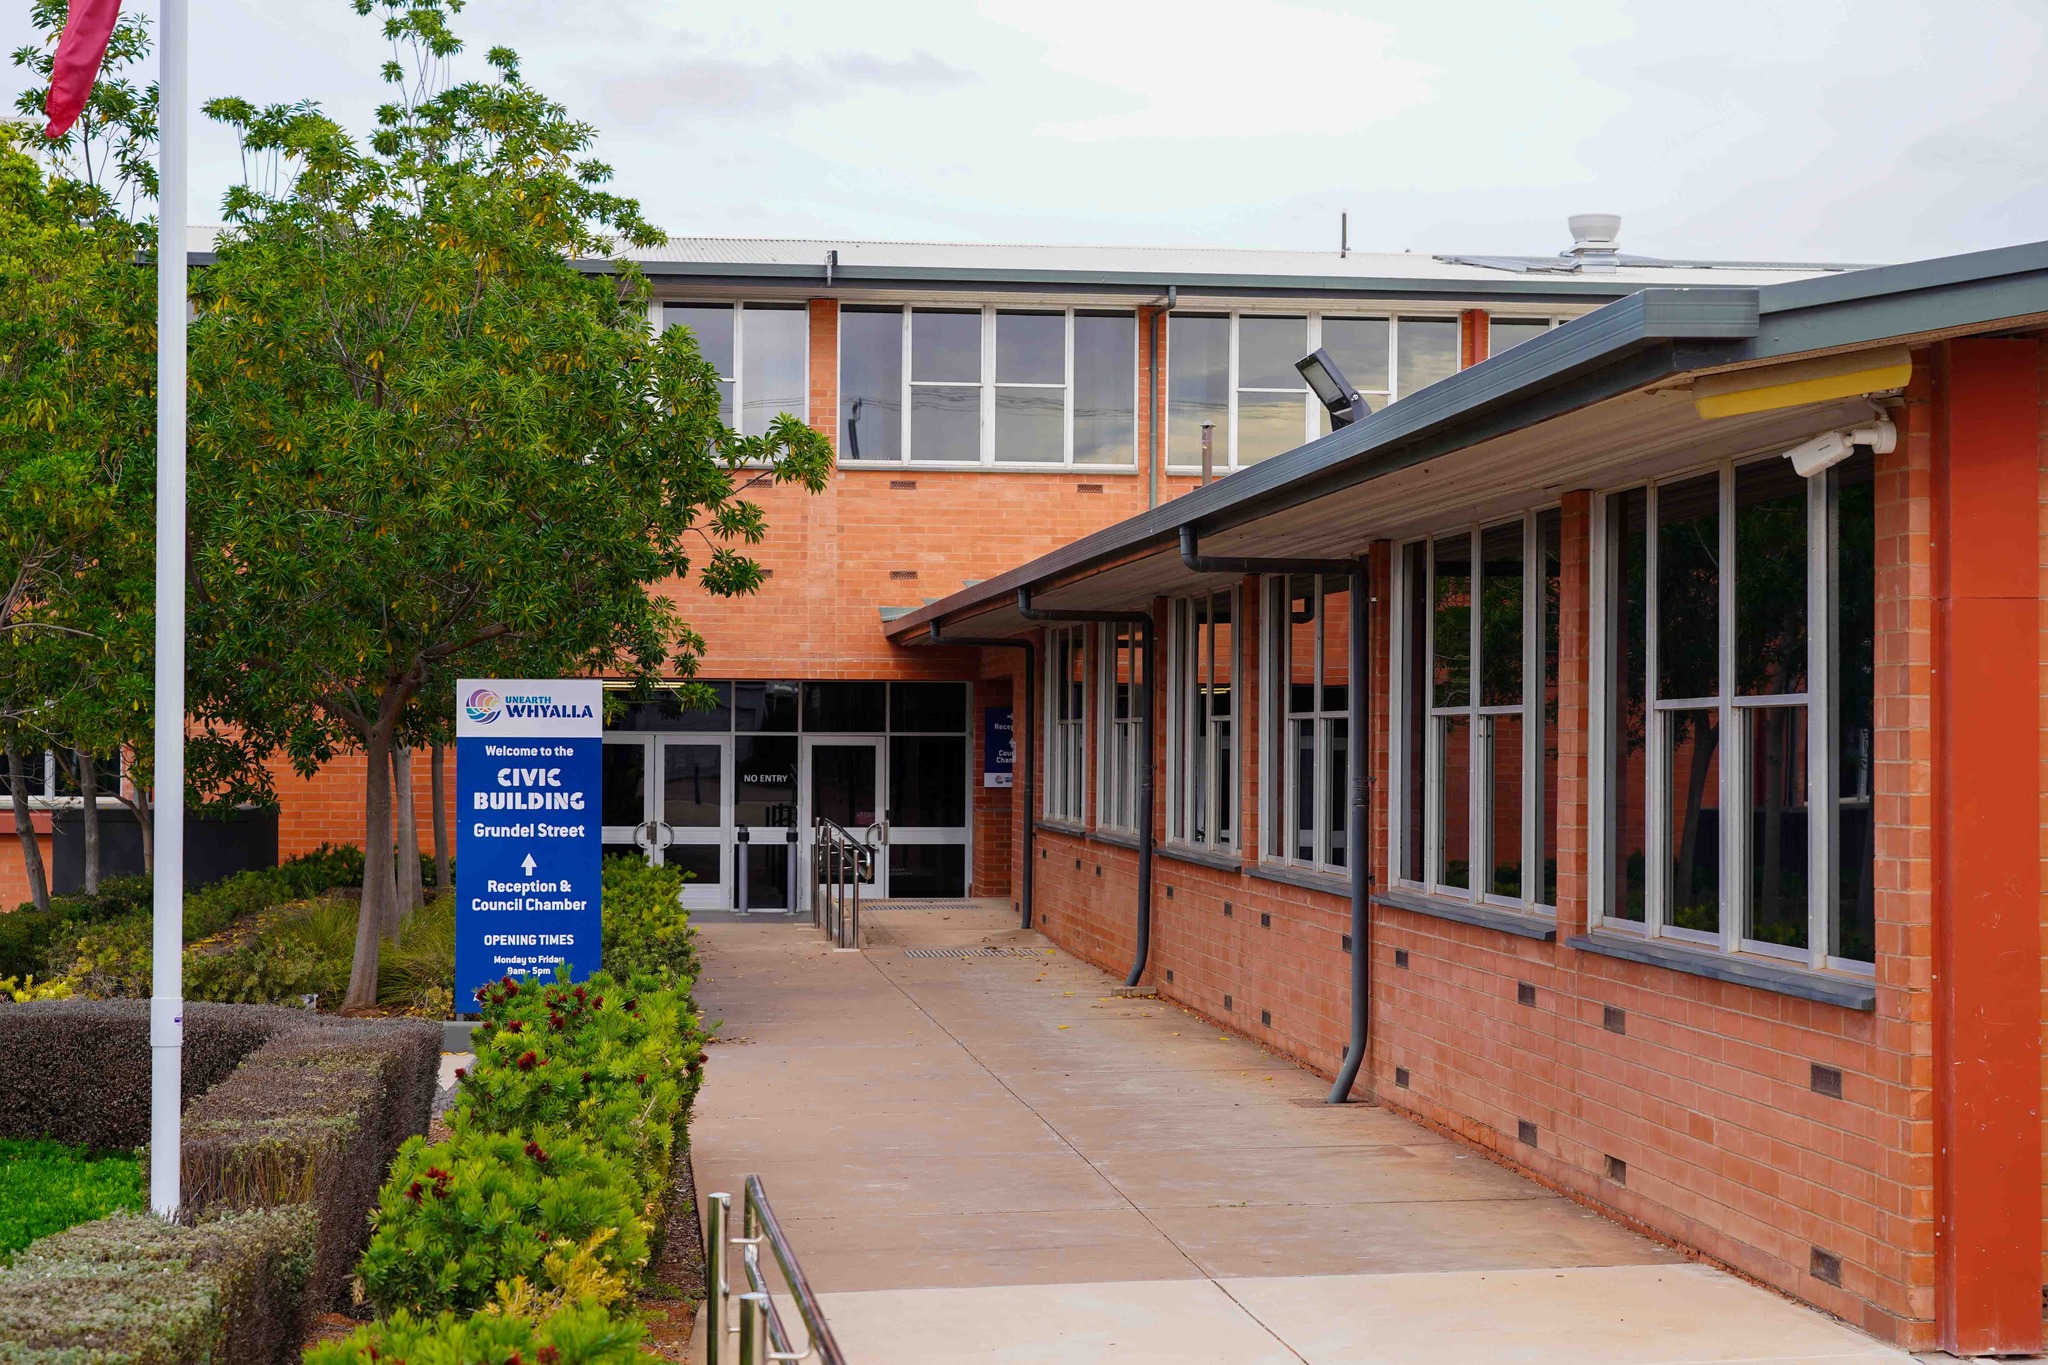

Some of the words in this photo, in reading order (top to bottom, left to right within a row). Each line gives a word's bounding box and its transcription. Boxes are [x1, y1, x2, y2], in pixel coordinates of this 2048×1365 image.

[505, 696, 552, 704] UNEARTH
[505, 705, 594, 718] WHYALLA
[485, 745, 538, 757] Welcome
[539, 746, 552, 757] to
[554, 745, 574, 757] the
[497, 767, 562, 787] CIVIC
[744, 774, 758, 783] NO
[759, 774, 788, 783] ENTRY
[473, 791, 585, 811] BUILDING
[473, 822, 535, 838] Grundel
[537, 822, 585, 838] Street
[487, 879, 557, 897] Reception
[559, 879, 572, 893] &
[471, 898, 523, 912] Council
[525, 897, 587, 911] Chamber
[483, 934, 537, 946] OPENING
[538, 934, 575, 945] TIMES
[493, 955, 527, 966] Monday
[528, 956, 537, 964] to
[507, 966, 526, 976] 9am
[532, 966, 551, 977] 5pm
